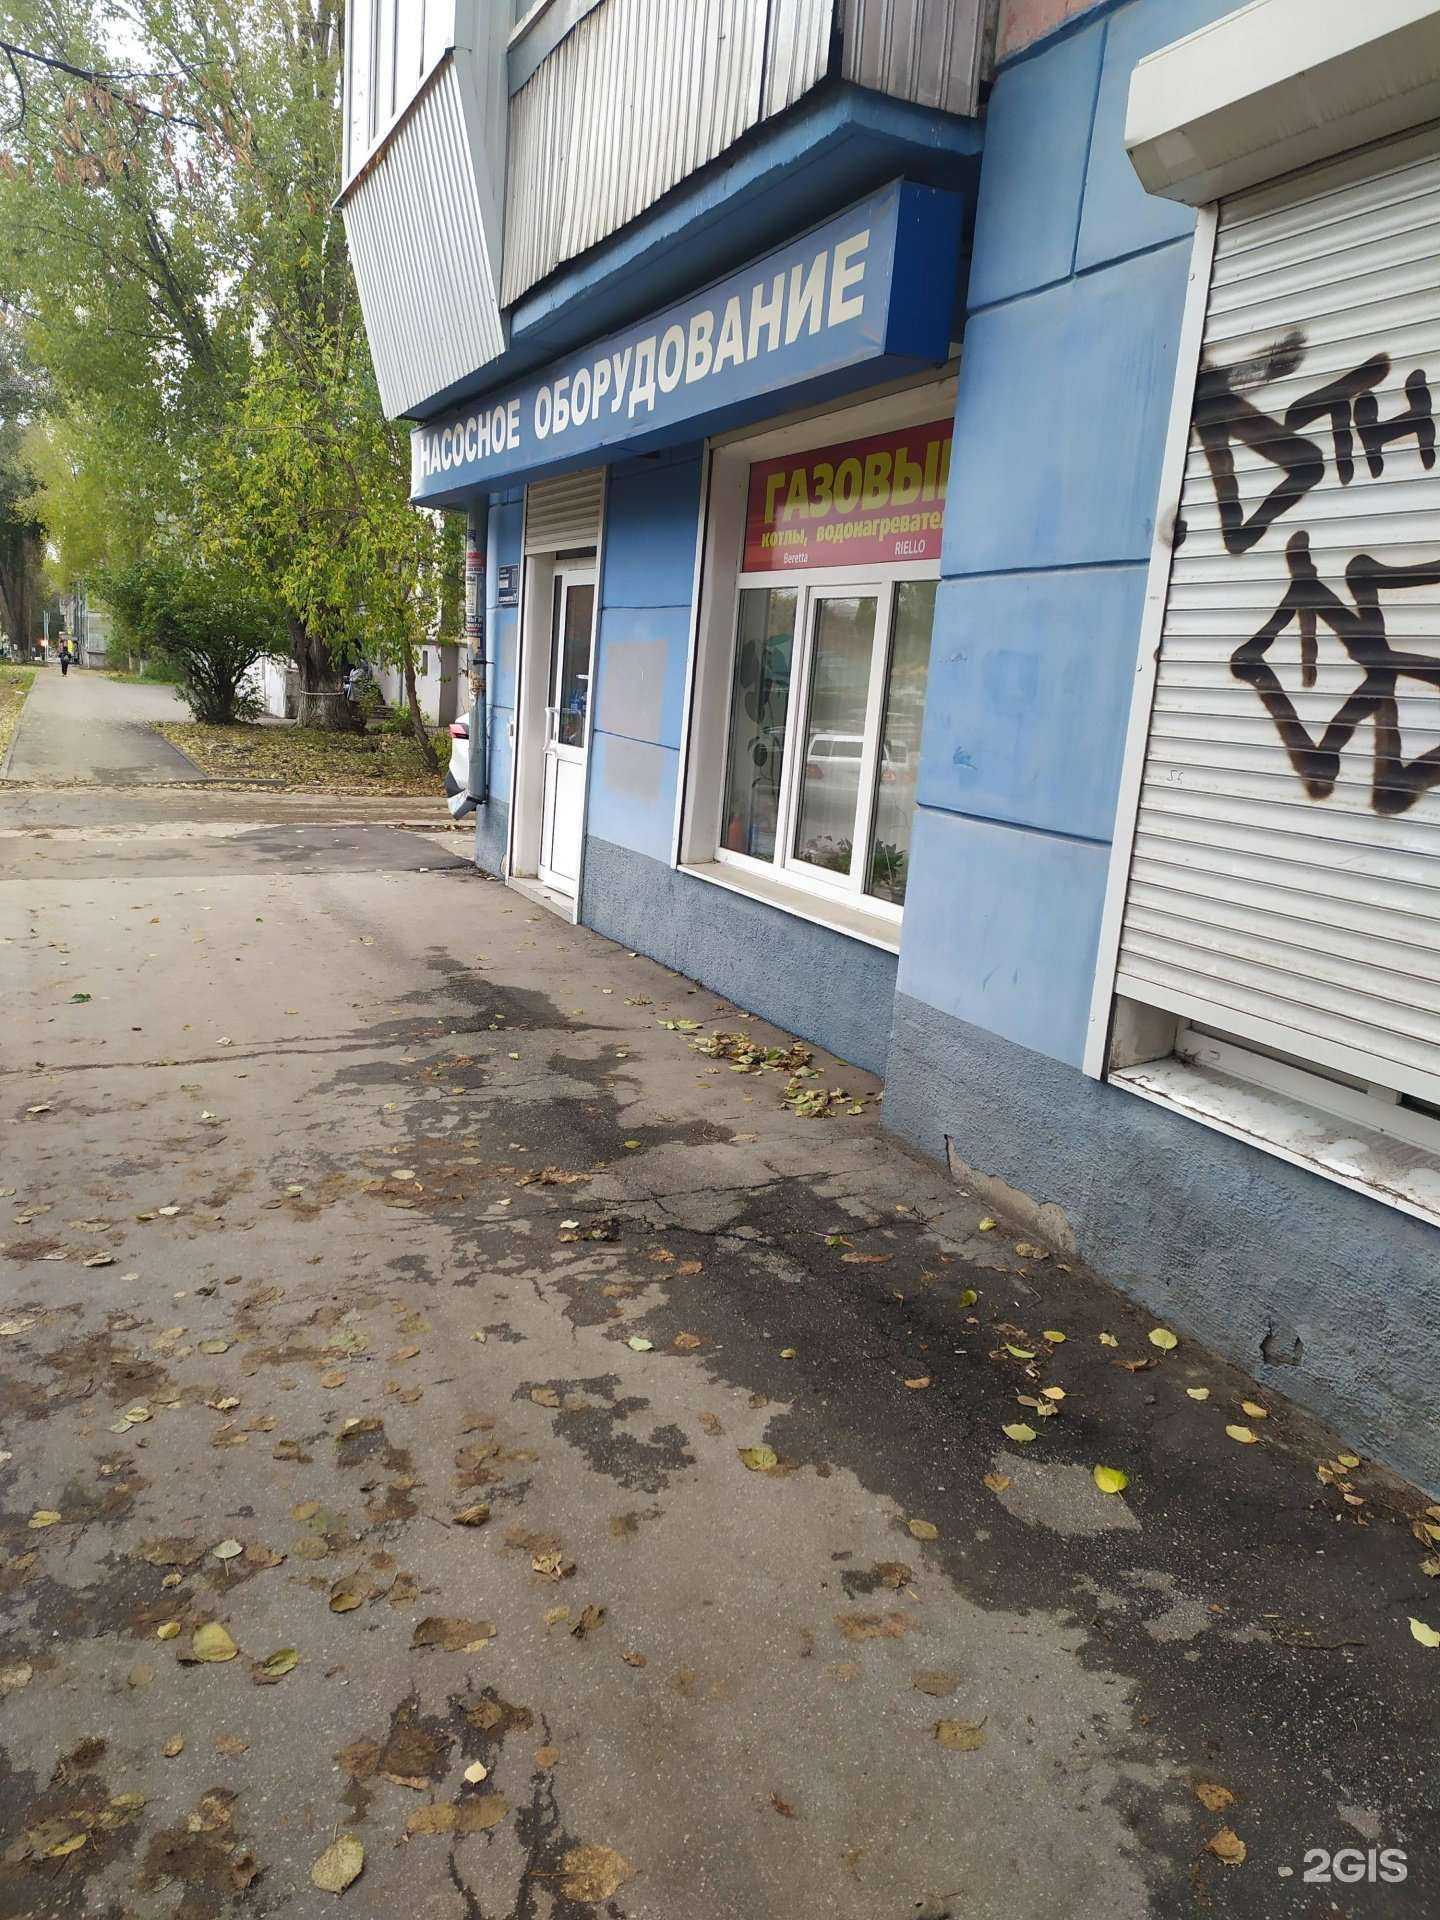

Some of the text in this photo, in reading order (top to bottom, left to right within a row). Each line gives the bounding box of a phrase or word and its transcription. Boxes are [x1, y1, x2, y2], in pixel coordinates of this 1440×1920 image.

[419, 229, 870, 477] НАСОСНОЕ ОБОРУДОВАНИЕ
[761, 509, 944, 549] котлы, водонагревате
[783, 551, 808, 564] Beretta
[894, 538, 926, 556] RIELLO
